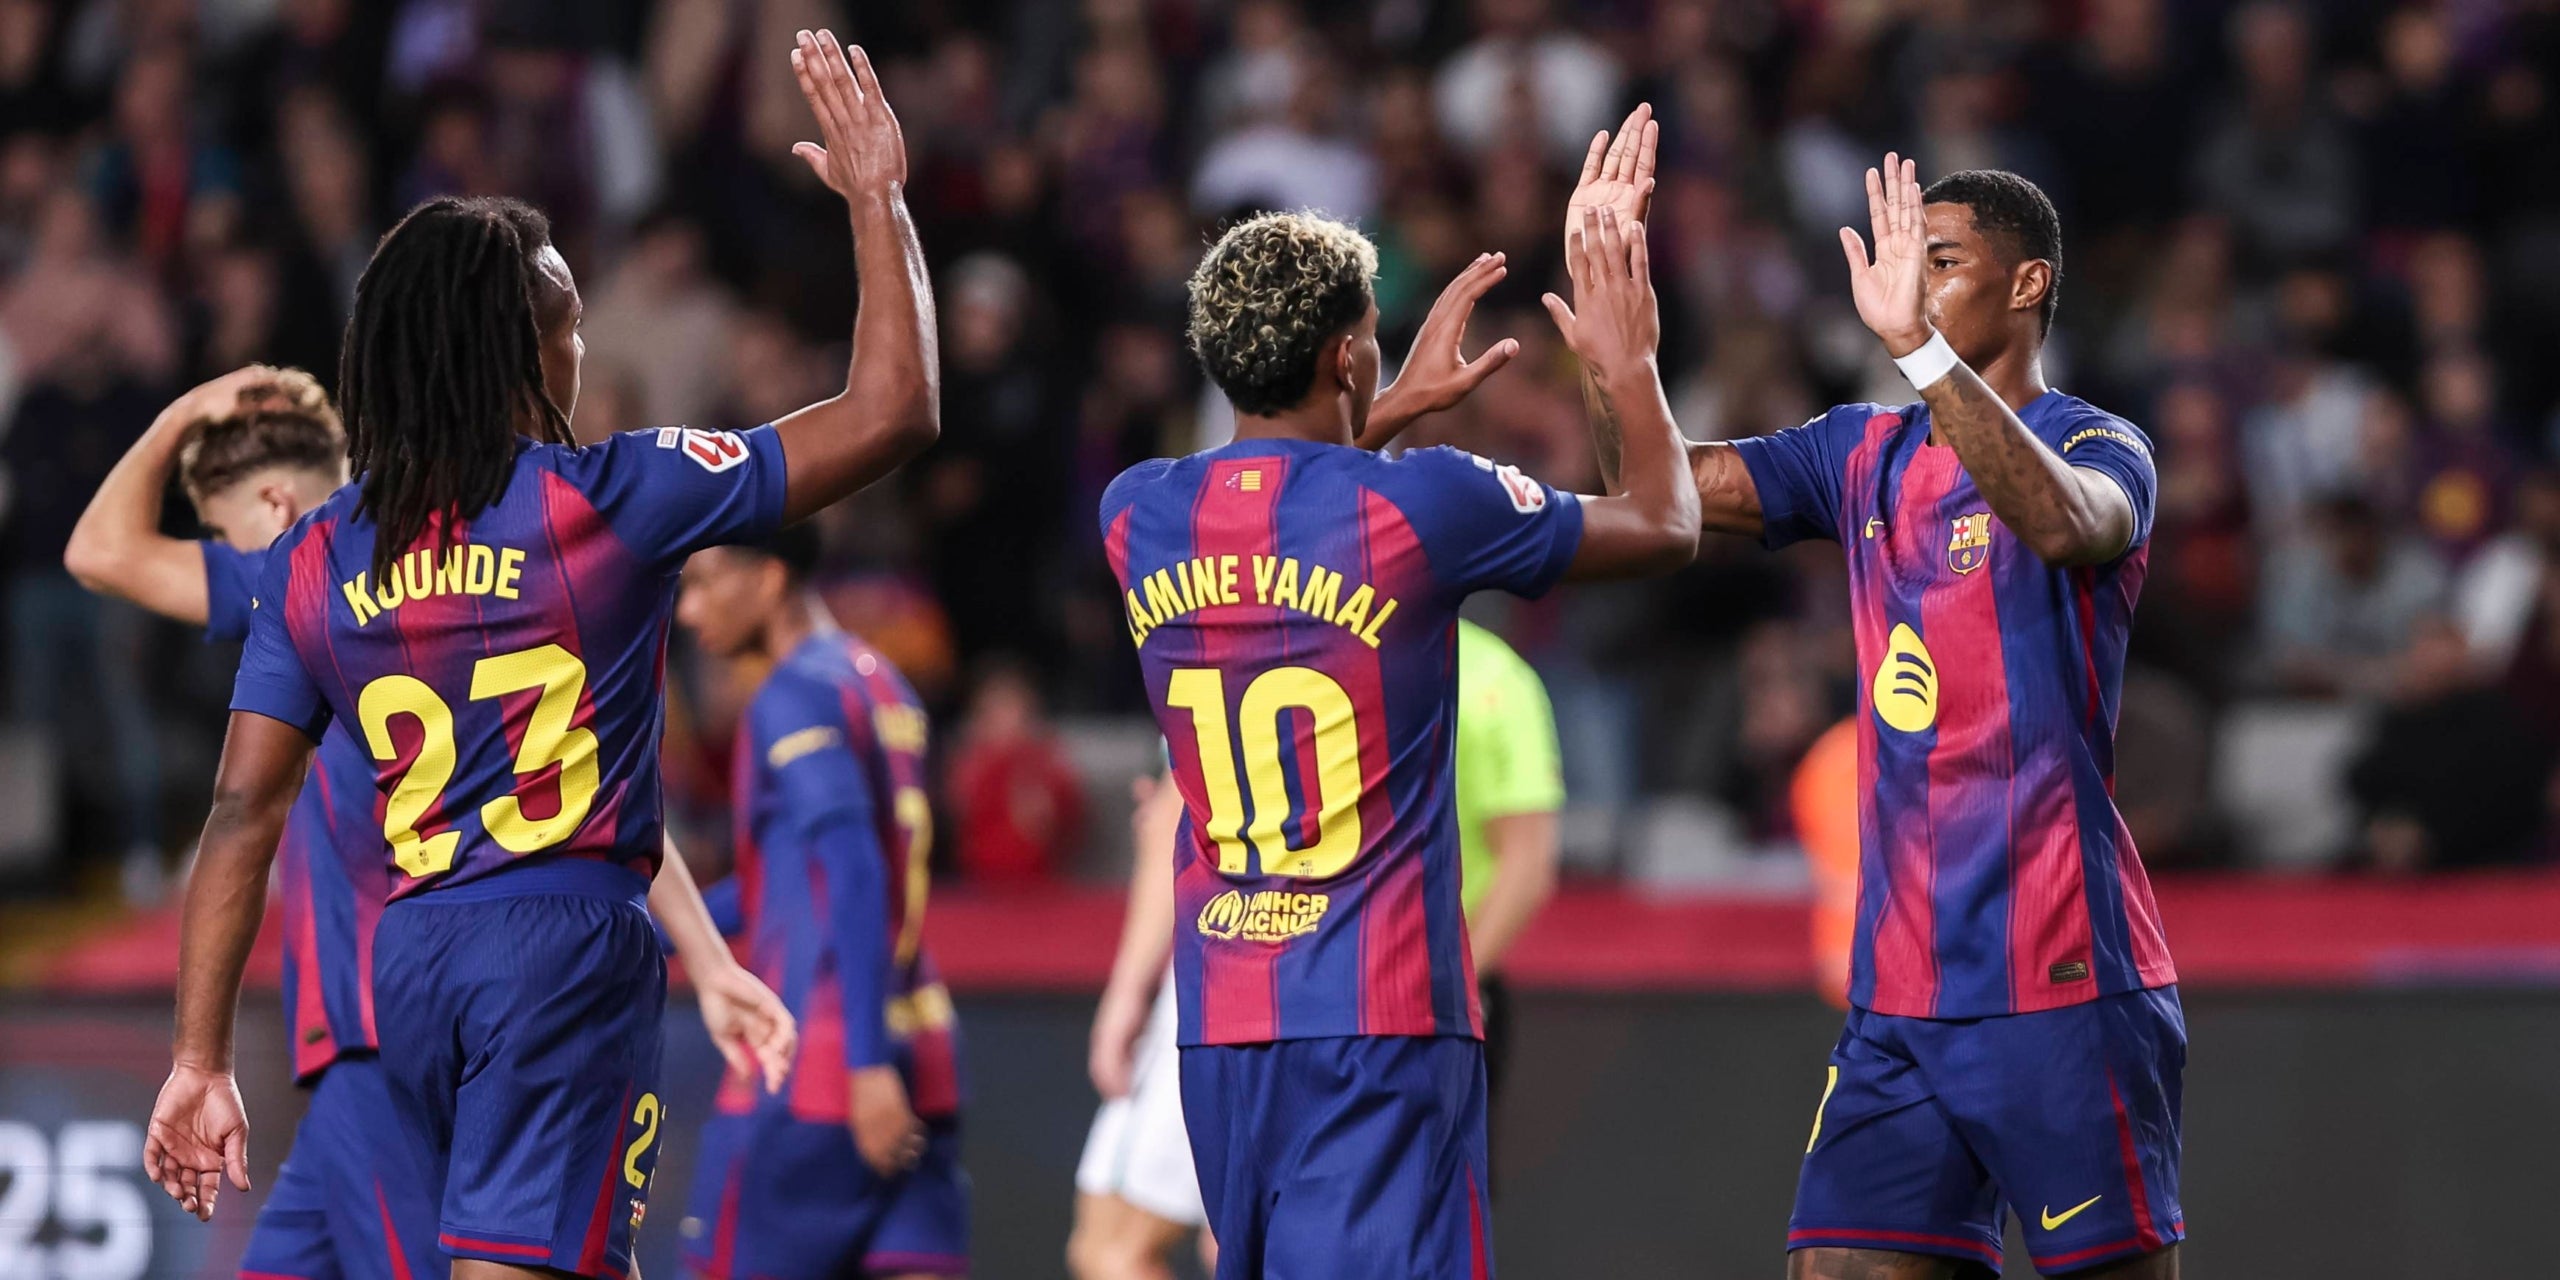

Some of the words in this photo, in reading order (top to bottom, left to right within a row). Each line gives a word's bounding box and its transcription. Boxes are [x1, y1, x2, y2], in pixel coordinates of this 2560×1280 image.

[343, 544, 526, 627] KOUNDE
[1252, 555, 1398, 649] YAMAL
[357, 643, 600, 878] 23
[1166, 666, 1363, 879] 10
[1250, 891, 1329, 914] UNHCR
[624, 1092, 667, 1193] 2
[0, 1120, 153, 1280] 25
